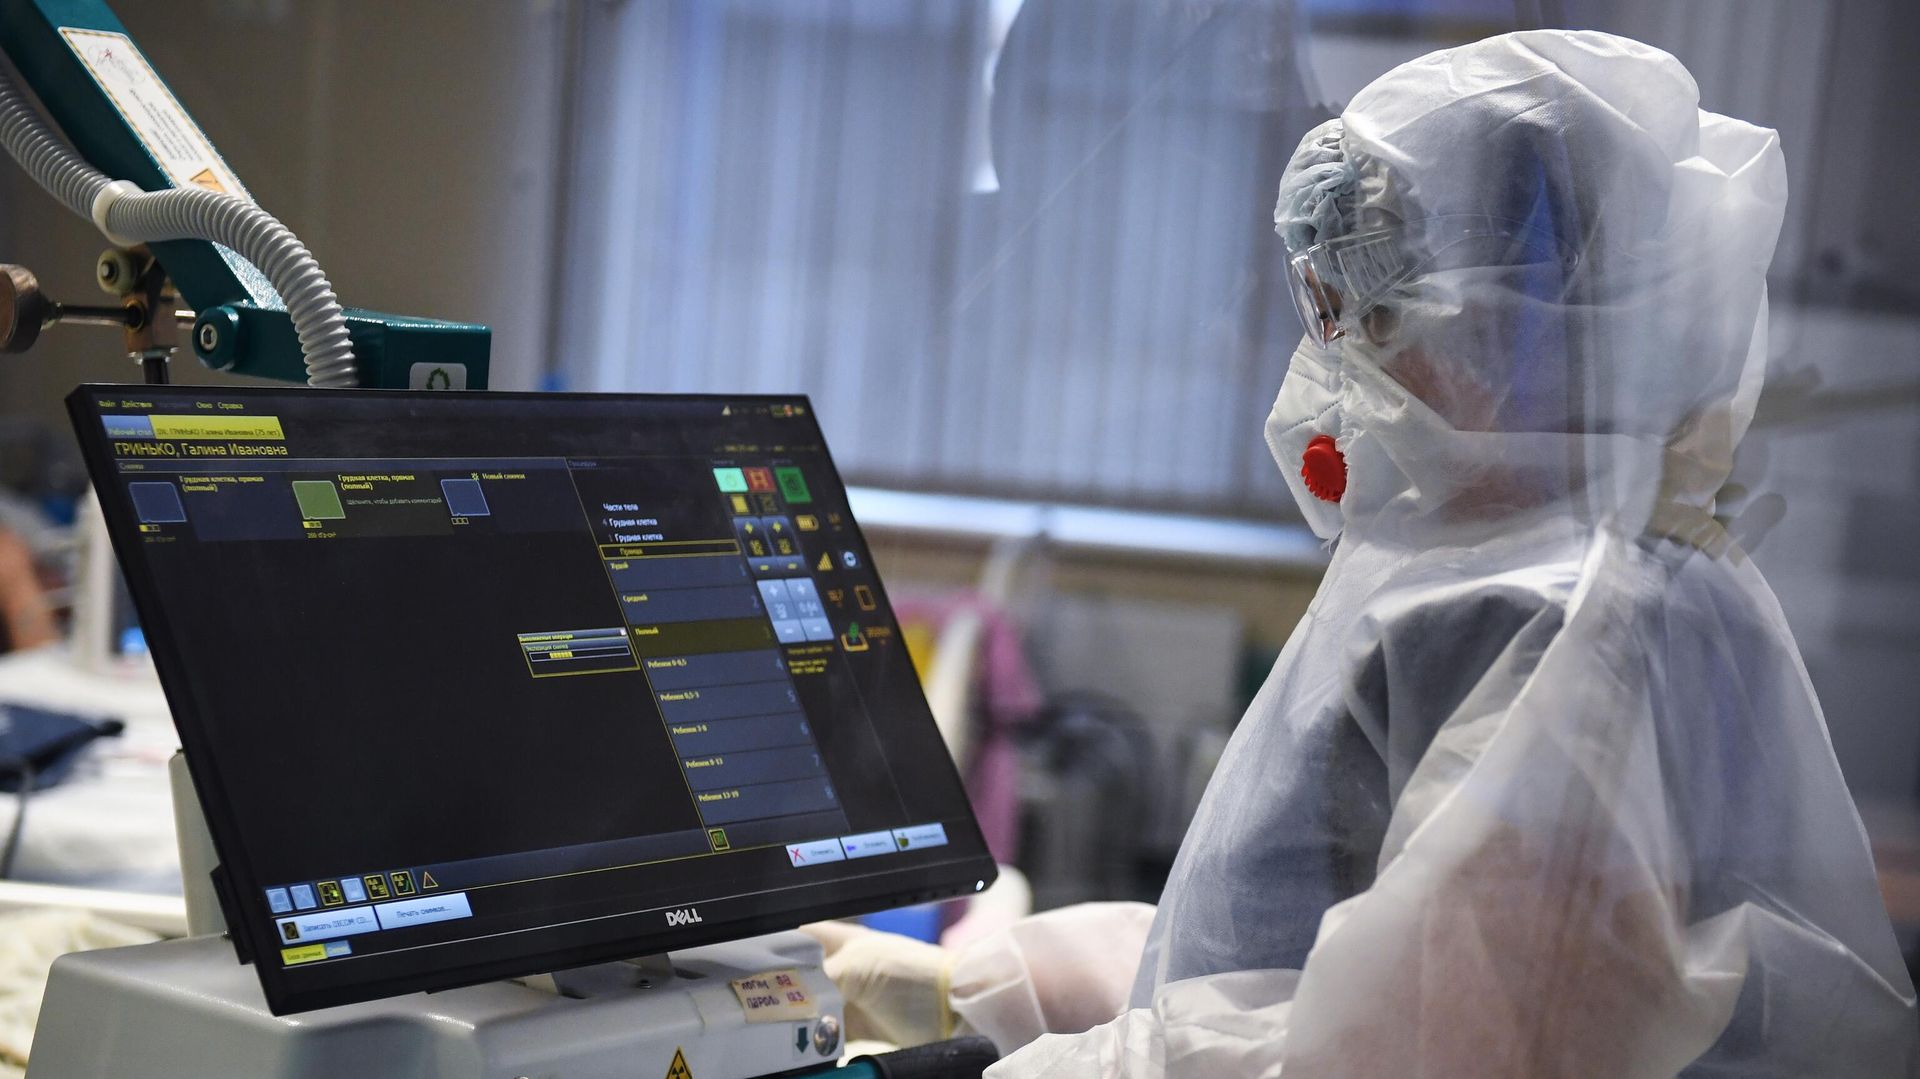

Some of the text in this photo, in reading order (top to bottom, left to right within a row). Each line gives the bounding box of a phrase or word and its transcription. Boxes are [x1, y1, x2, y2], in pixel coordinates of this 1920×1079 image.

[114, 442, 288, 458] ГРИНЬКО, Галина Ивановна
[338, 474, 365, 482] Грудная
[366, 474, 391, 482] клетка,
[340, 482, 374, 491] (полный)
[603, 503, 639, 512] Части тела
[609, 518, 635, 528] Грудная
[636, 518, 658, 527] клетка
[614, 533, 641, 543] Грудная
[642, 533, 664, 541] клетка
[665, 908, 703, 927] DELL
